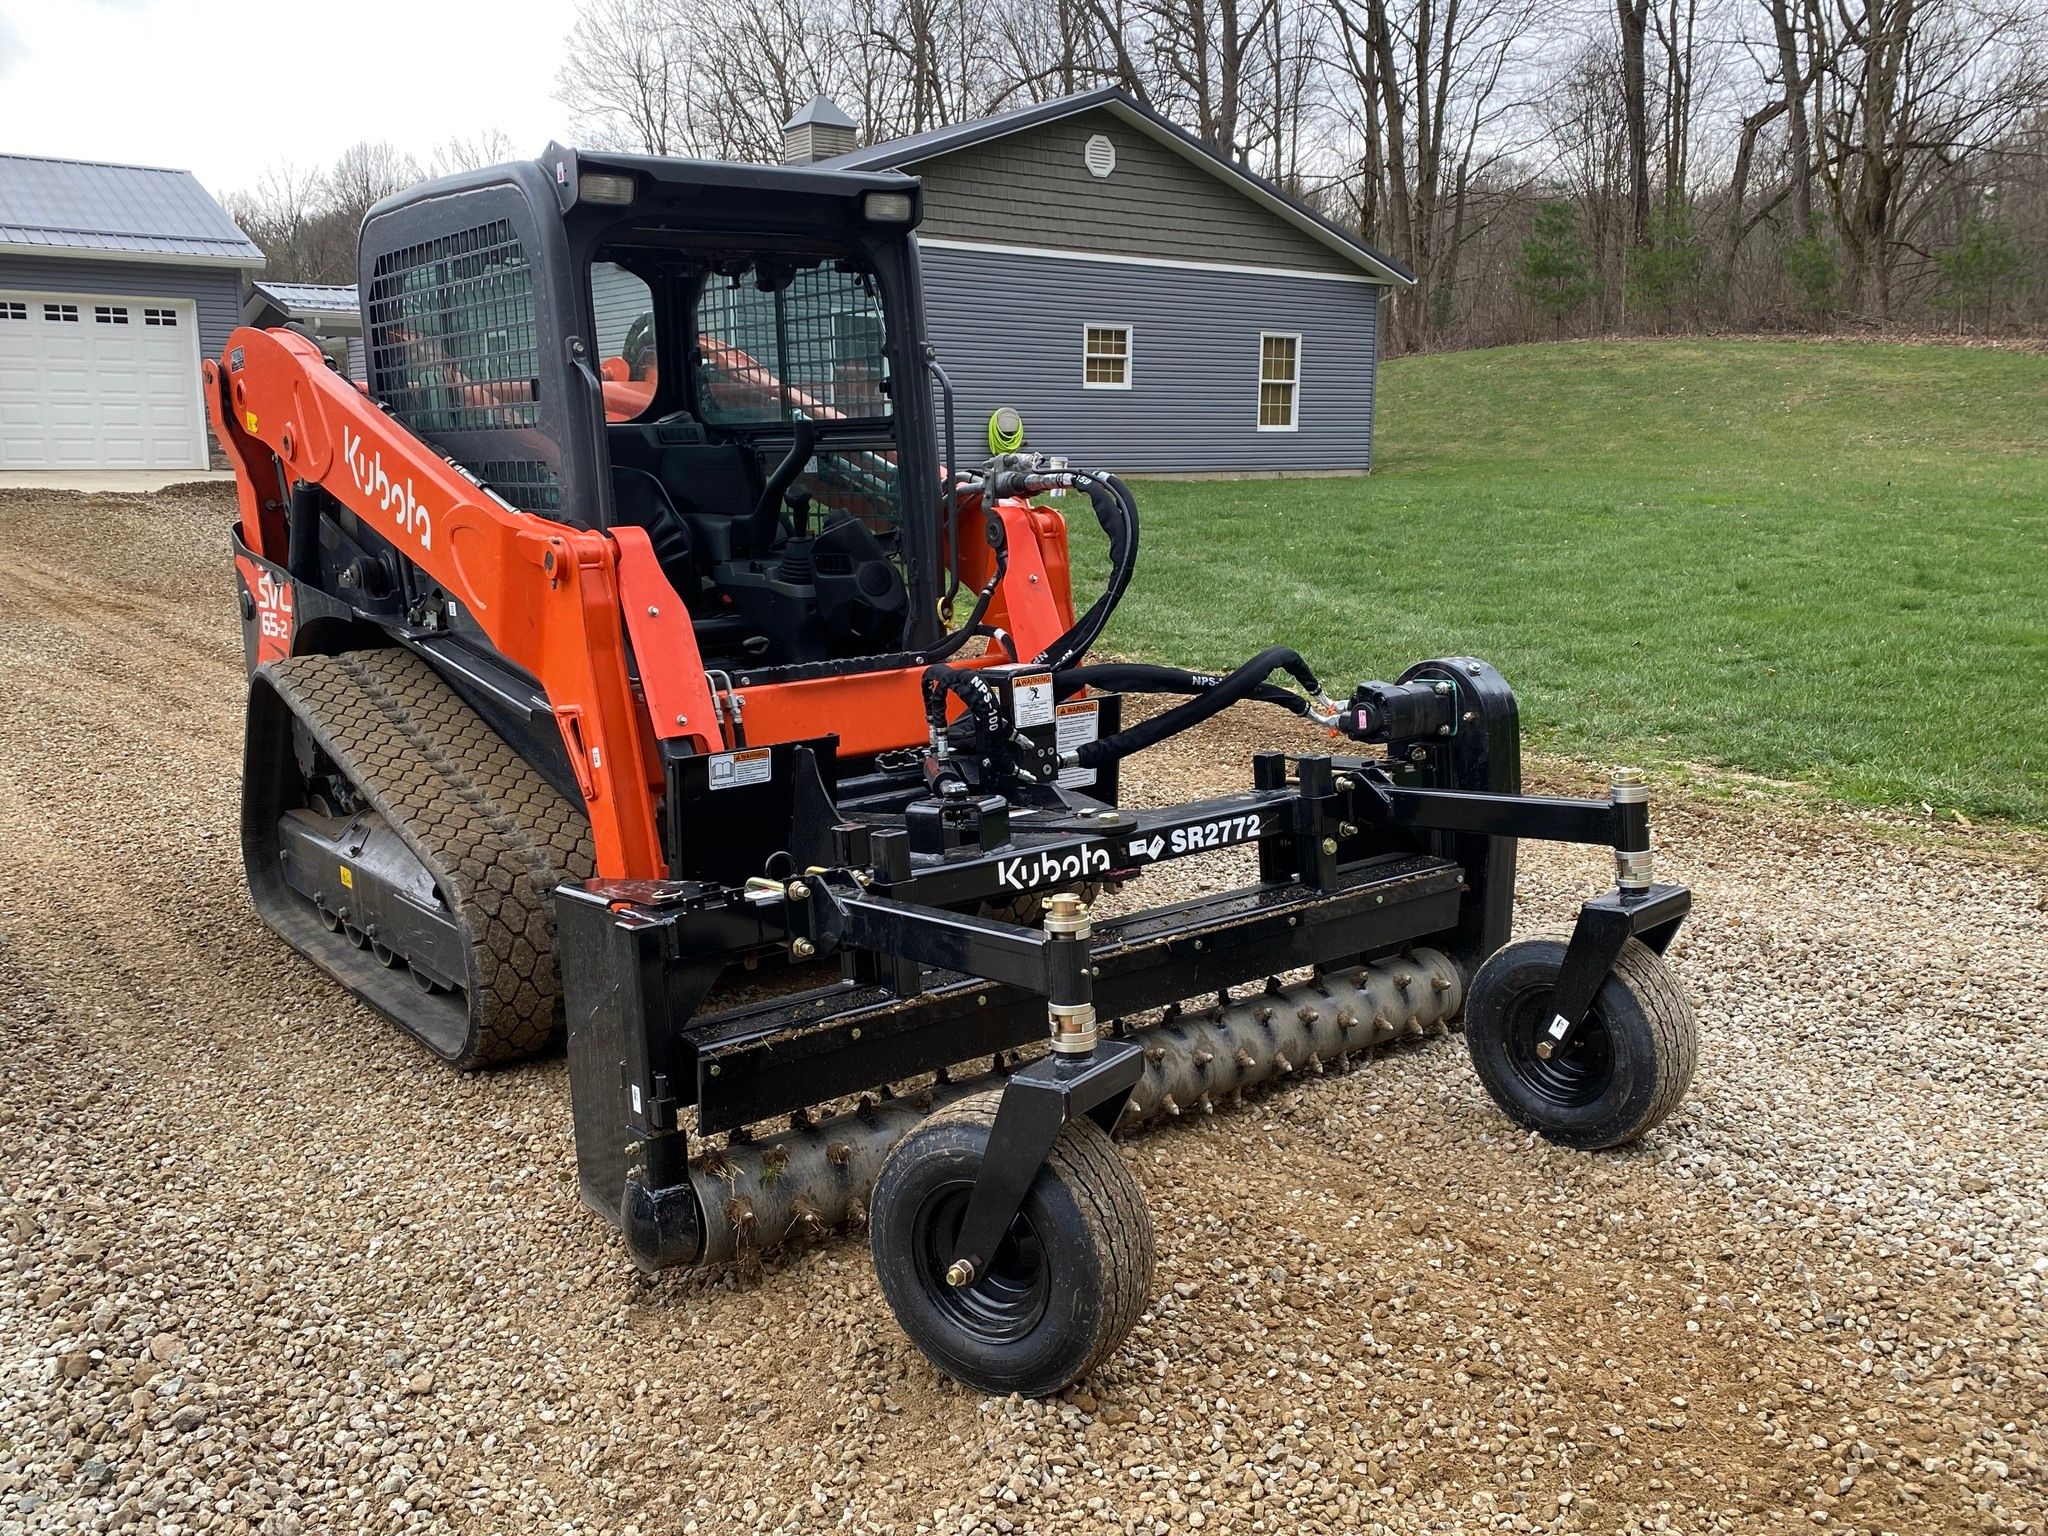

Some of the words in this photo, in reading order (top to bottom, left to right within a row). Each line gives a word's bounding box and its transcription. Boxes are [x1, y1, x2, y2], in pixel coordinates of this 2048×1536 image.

[344, 425, 431, 551] Kubota
[262, 611, 288, 639] 65-2
[1020, 675, 1050, 686] WARNING
[970, 675, 999, 731] NPS-100
[1067, 703, 1095, 713] WARNING
[998, 843, 1110, 890] Kubota
[1171, 815, 1261, 854] SR2772
